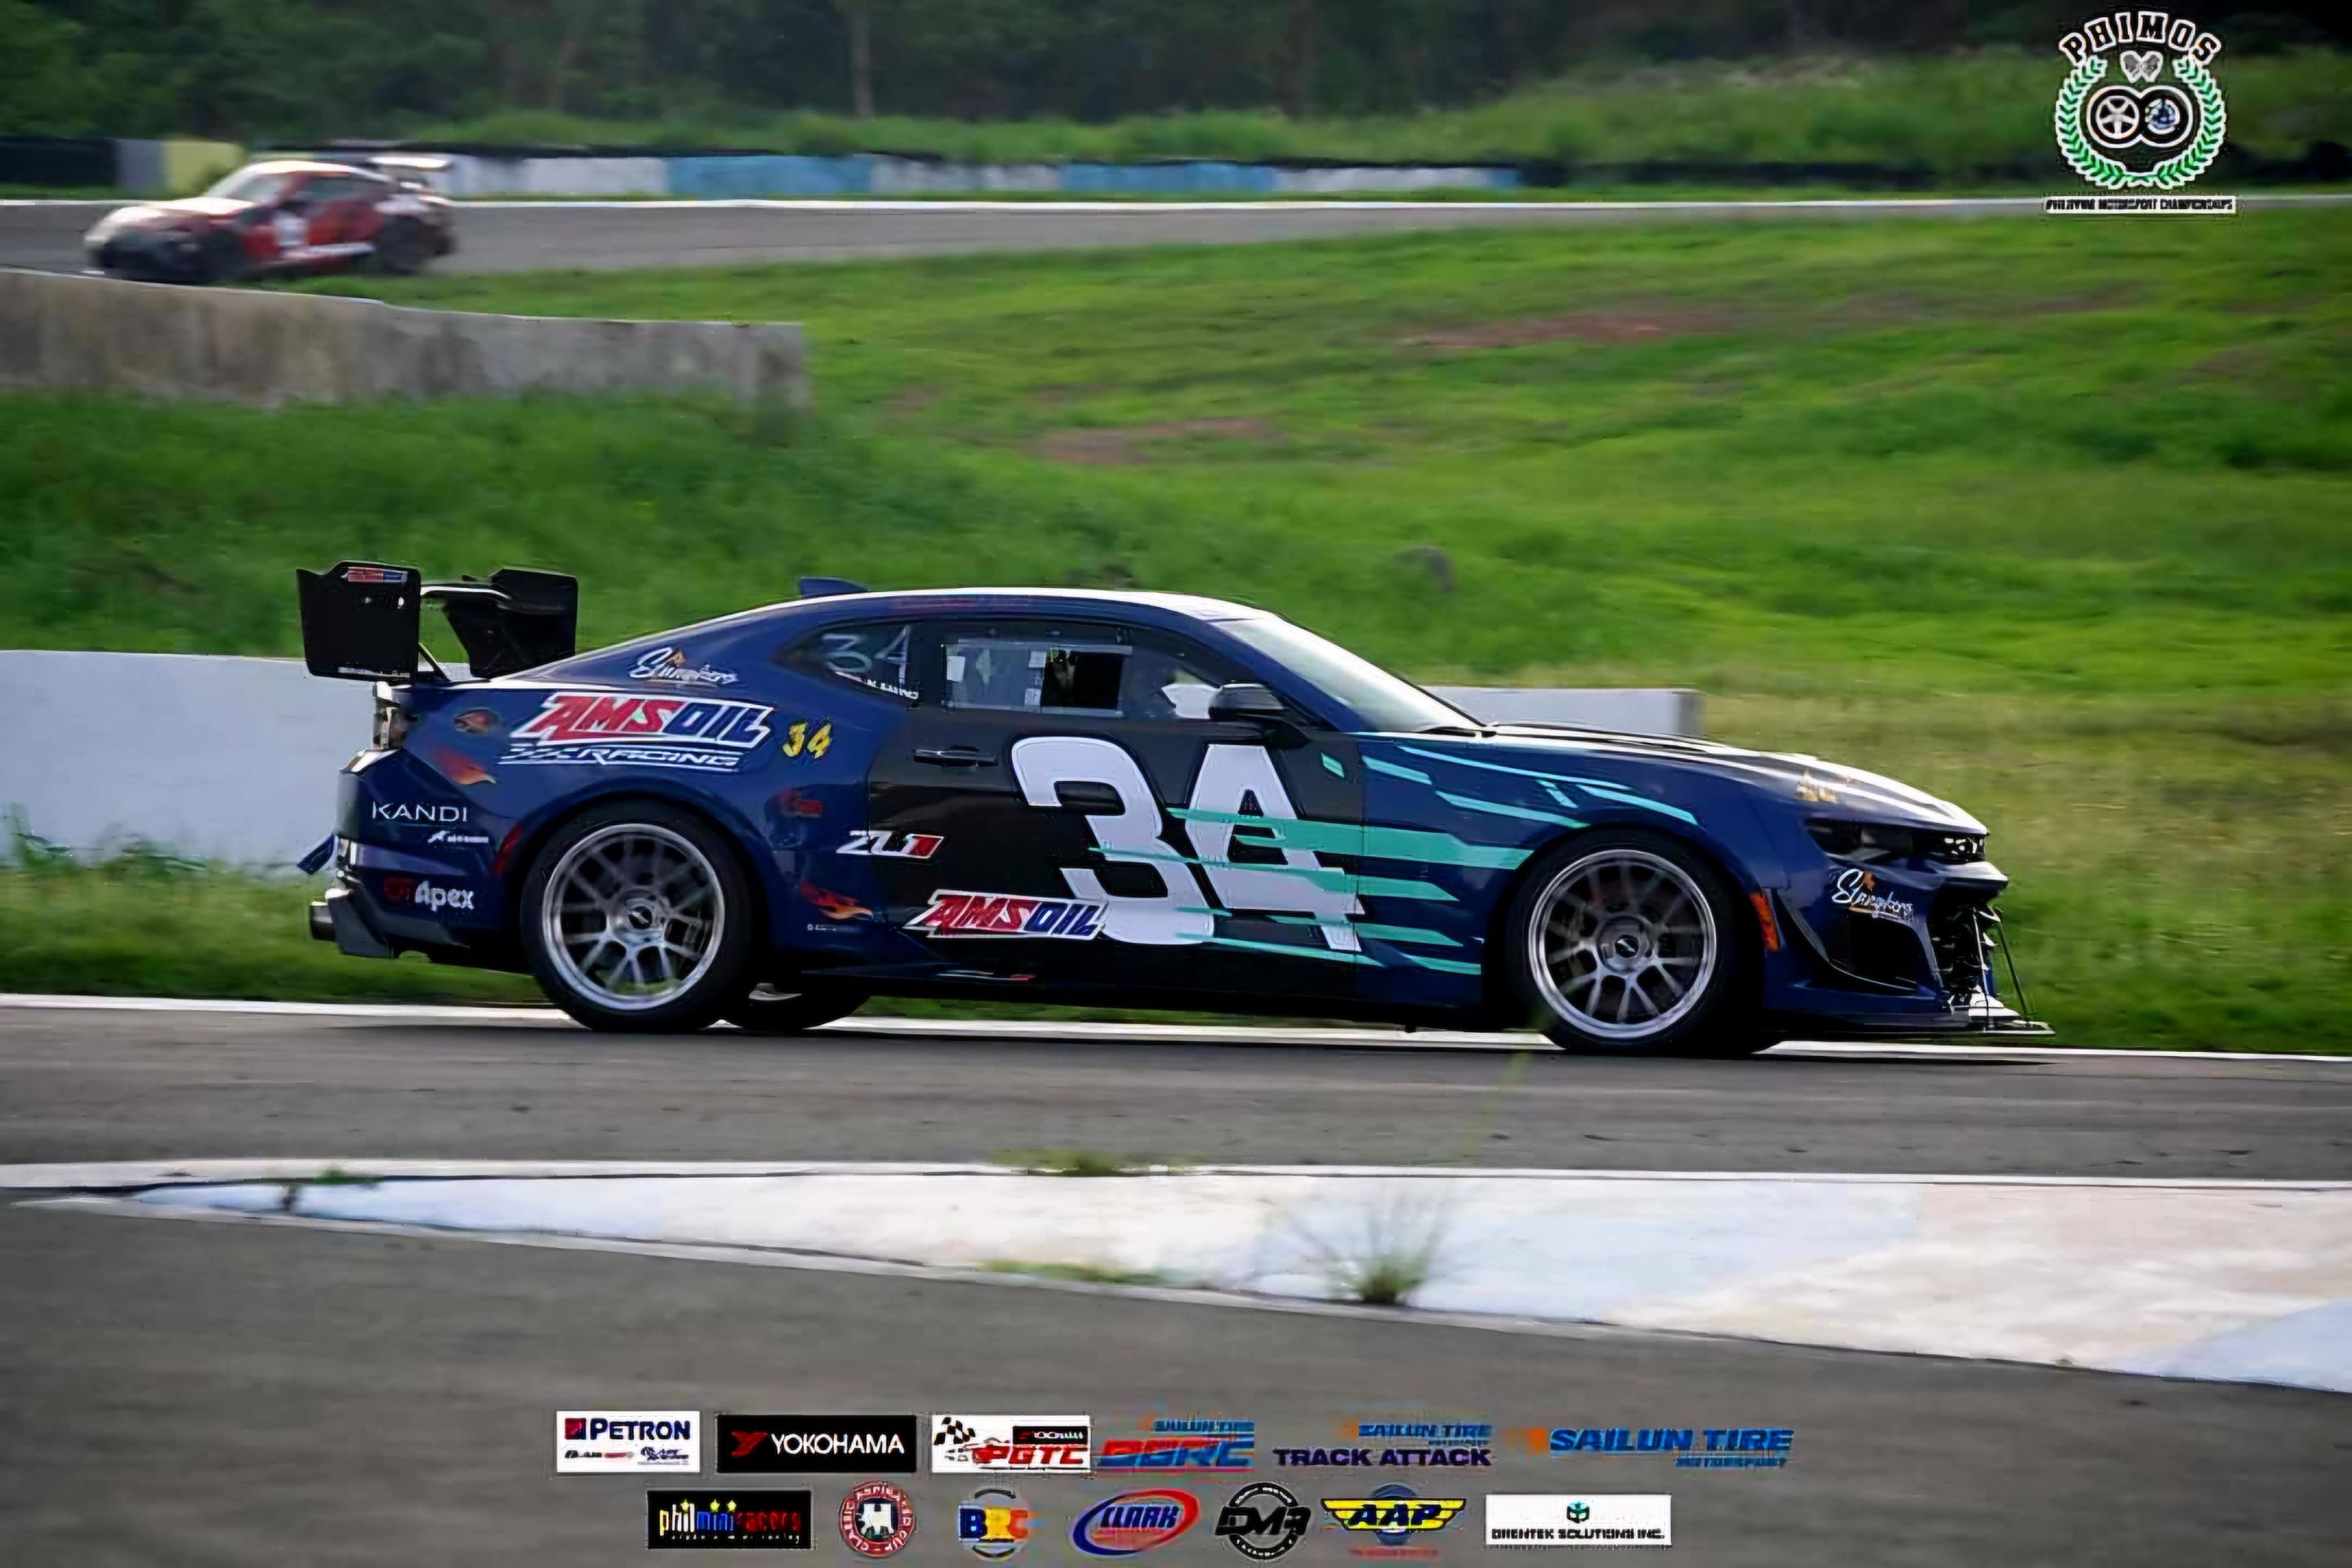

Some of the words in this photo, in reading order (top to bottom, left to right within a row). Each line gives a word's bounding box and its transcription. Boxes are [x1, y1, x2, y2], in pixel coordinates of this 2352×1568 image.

[822, 624, 911, 685] 34
[510, 691, 777, 749] AMSOIL
[577, 746, 740, 767] RACING
[372, 801, 469, 822] KANDI
[902, 889, 1109, 941] AMSOIL
